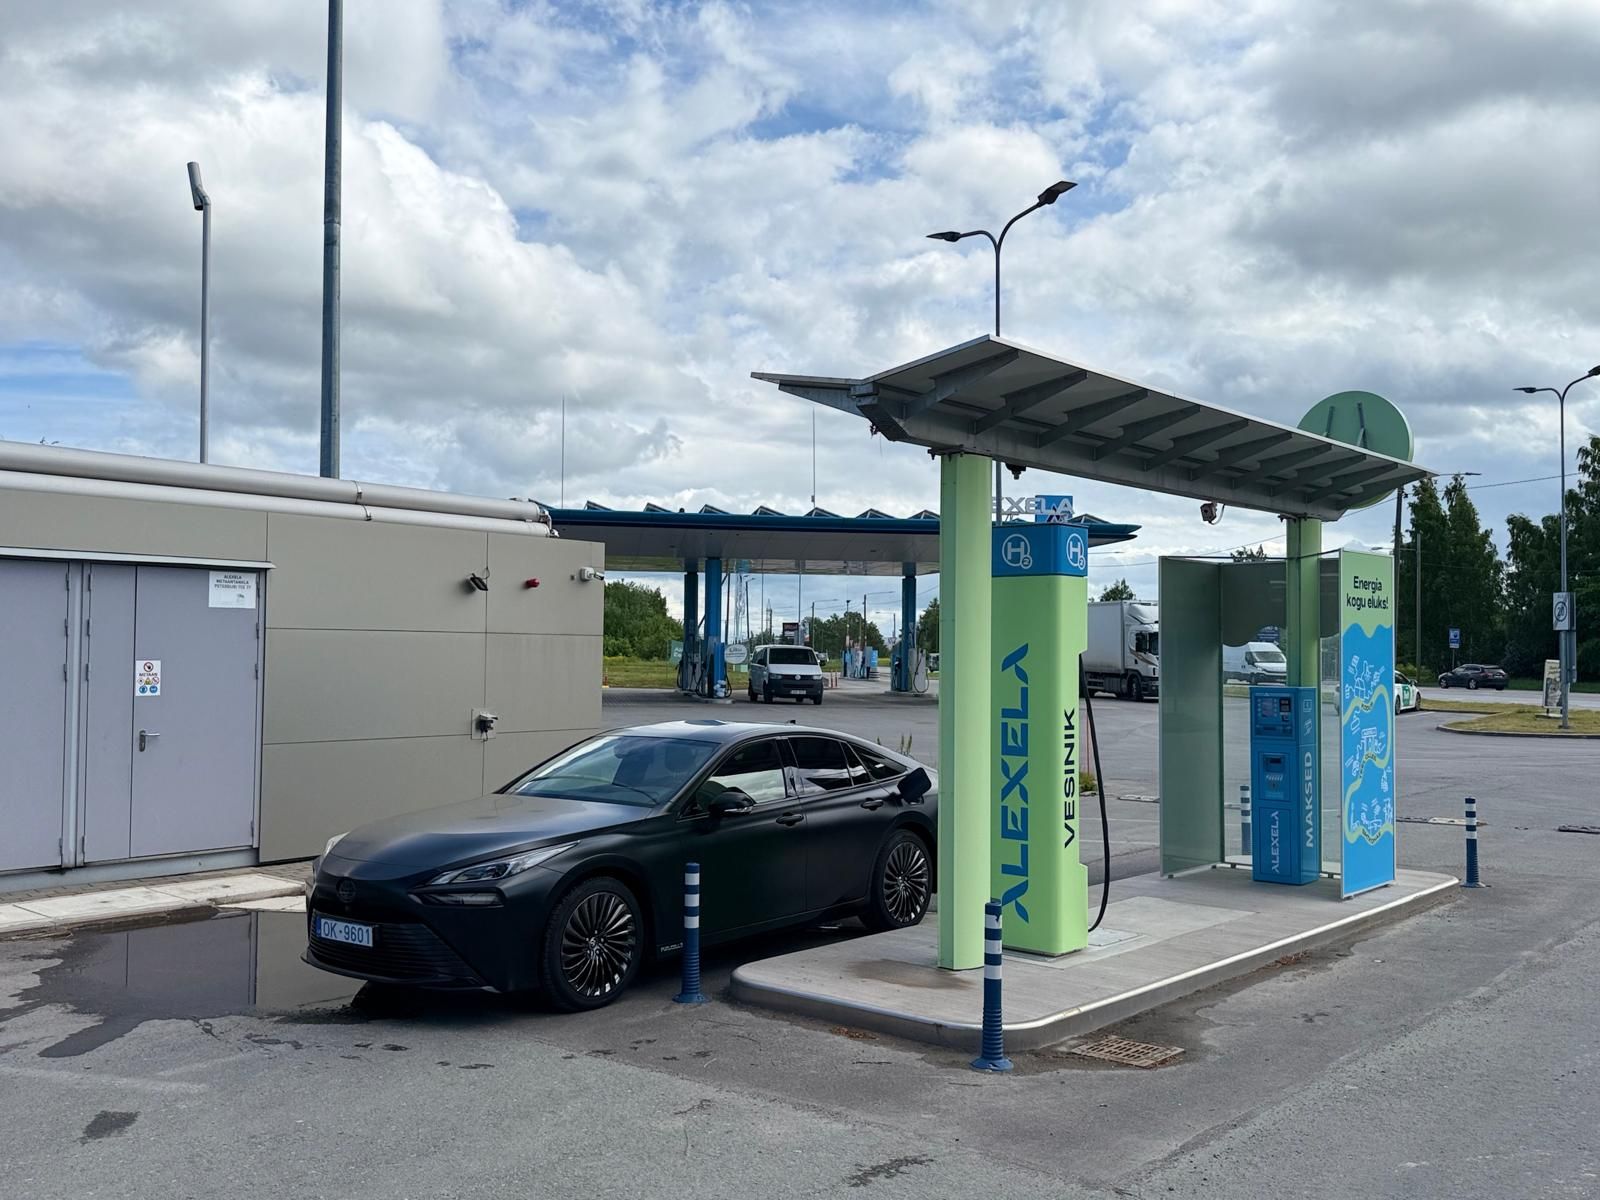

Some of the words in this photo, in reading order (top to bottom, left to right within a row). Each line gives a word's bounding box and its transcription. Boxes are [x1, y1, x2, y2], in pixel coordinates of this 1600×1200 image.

[1346, 592, 1366, 611] kogu
[1367, 594, 1389, 610] eluks!
[1353, 575, 1382, 594] Energia
[1001, 643, 1029, 924] ALEXELA
[1063, 707, 1076, 849] VESINIK
[1304, 751, 1314, 848] MAKSED
[1271, 810, 1280, 873] ALEXELA
[323, 921, 370, 945] OK-9601
